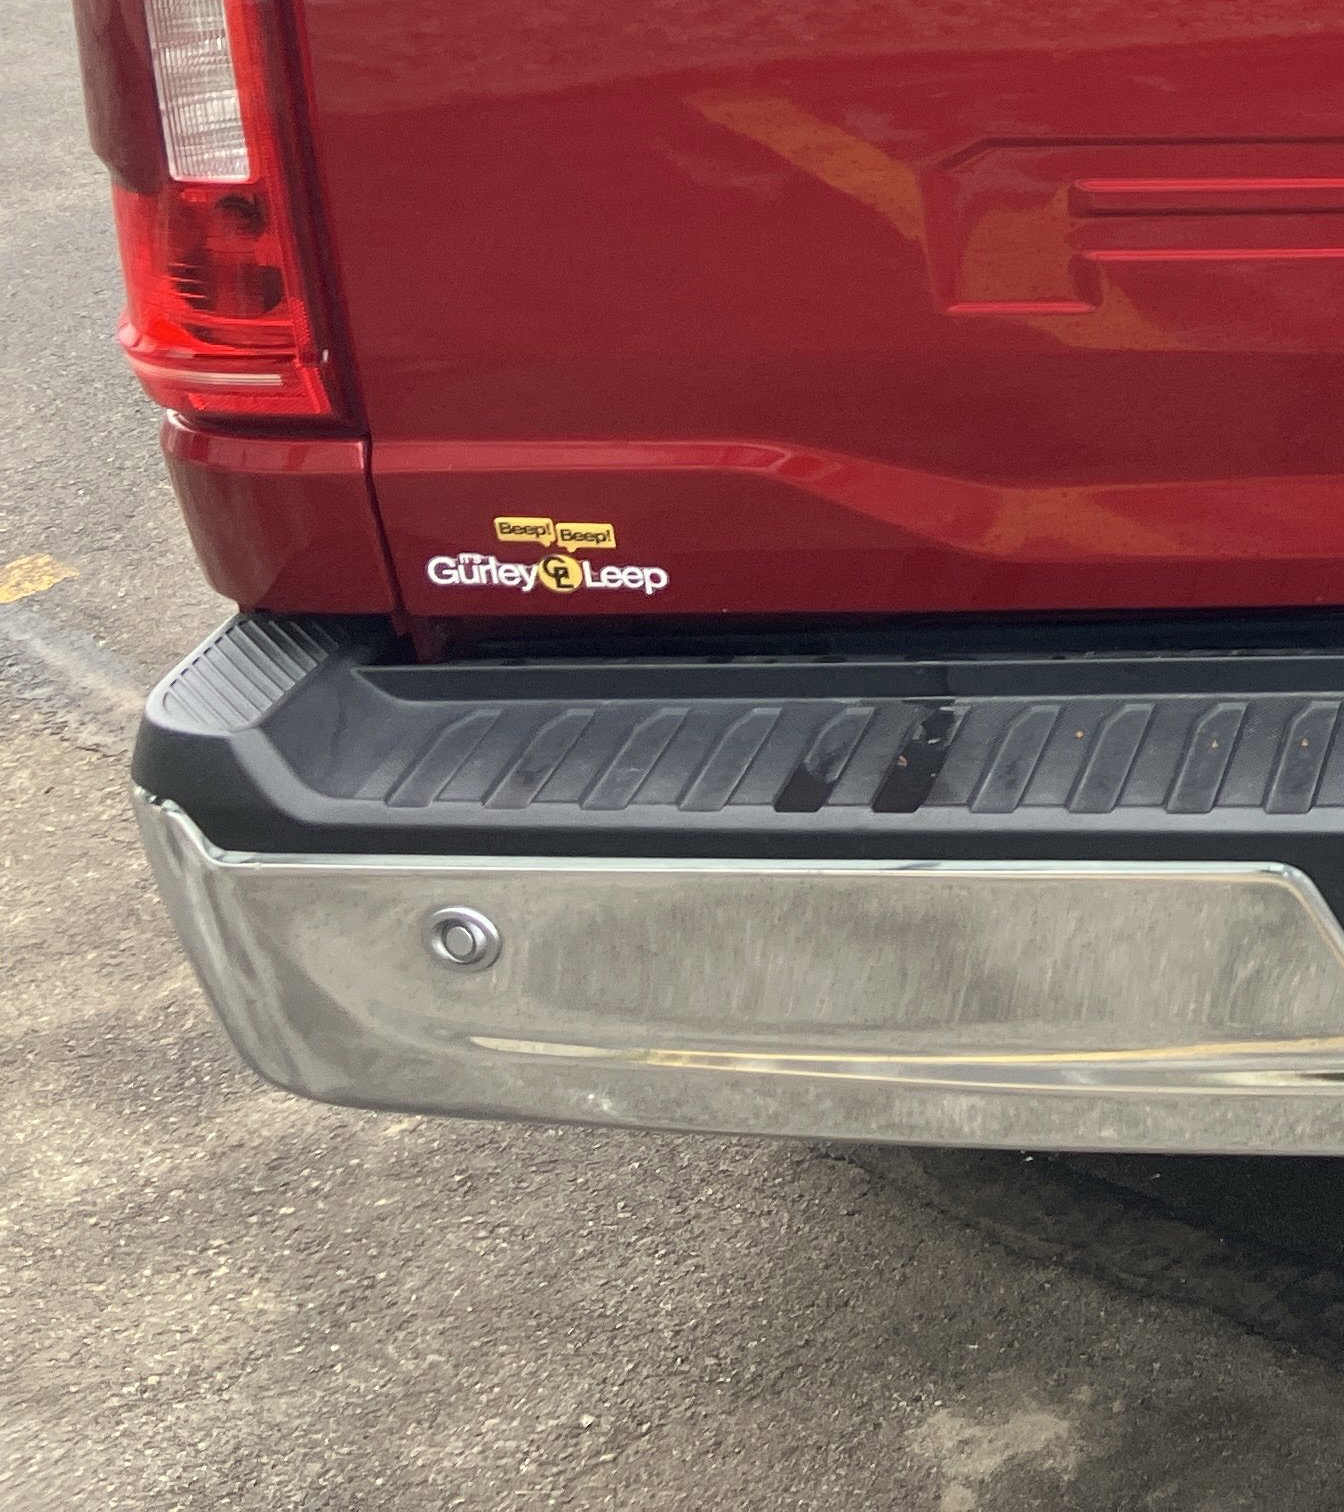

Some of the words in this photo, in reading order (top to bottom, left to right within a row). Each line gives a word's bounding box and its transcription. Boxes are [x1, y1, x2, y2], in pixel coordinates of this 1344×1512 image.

[499, 521, 552, 538] Beep!
[560, 528, 611, 544] Beep!
[427, 556, 539, 592] Gurley
[581, 560, 669, 595] Leep
